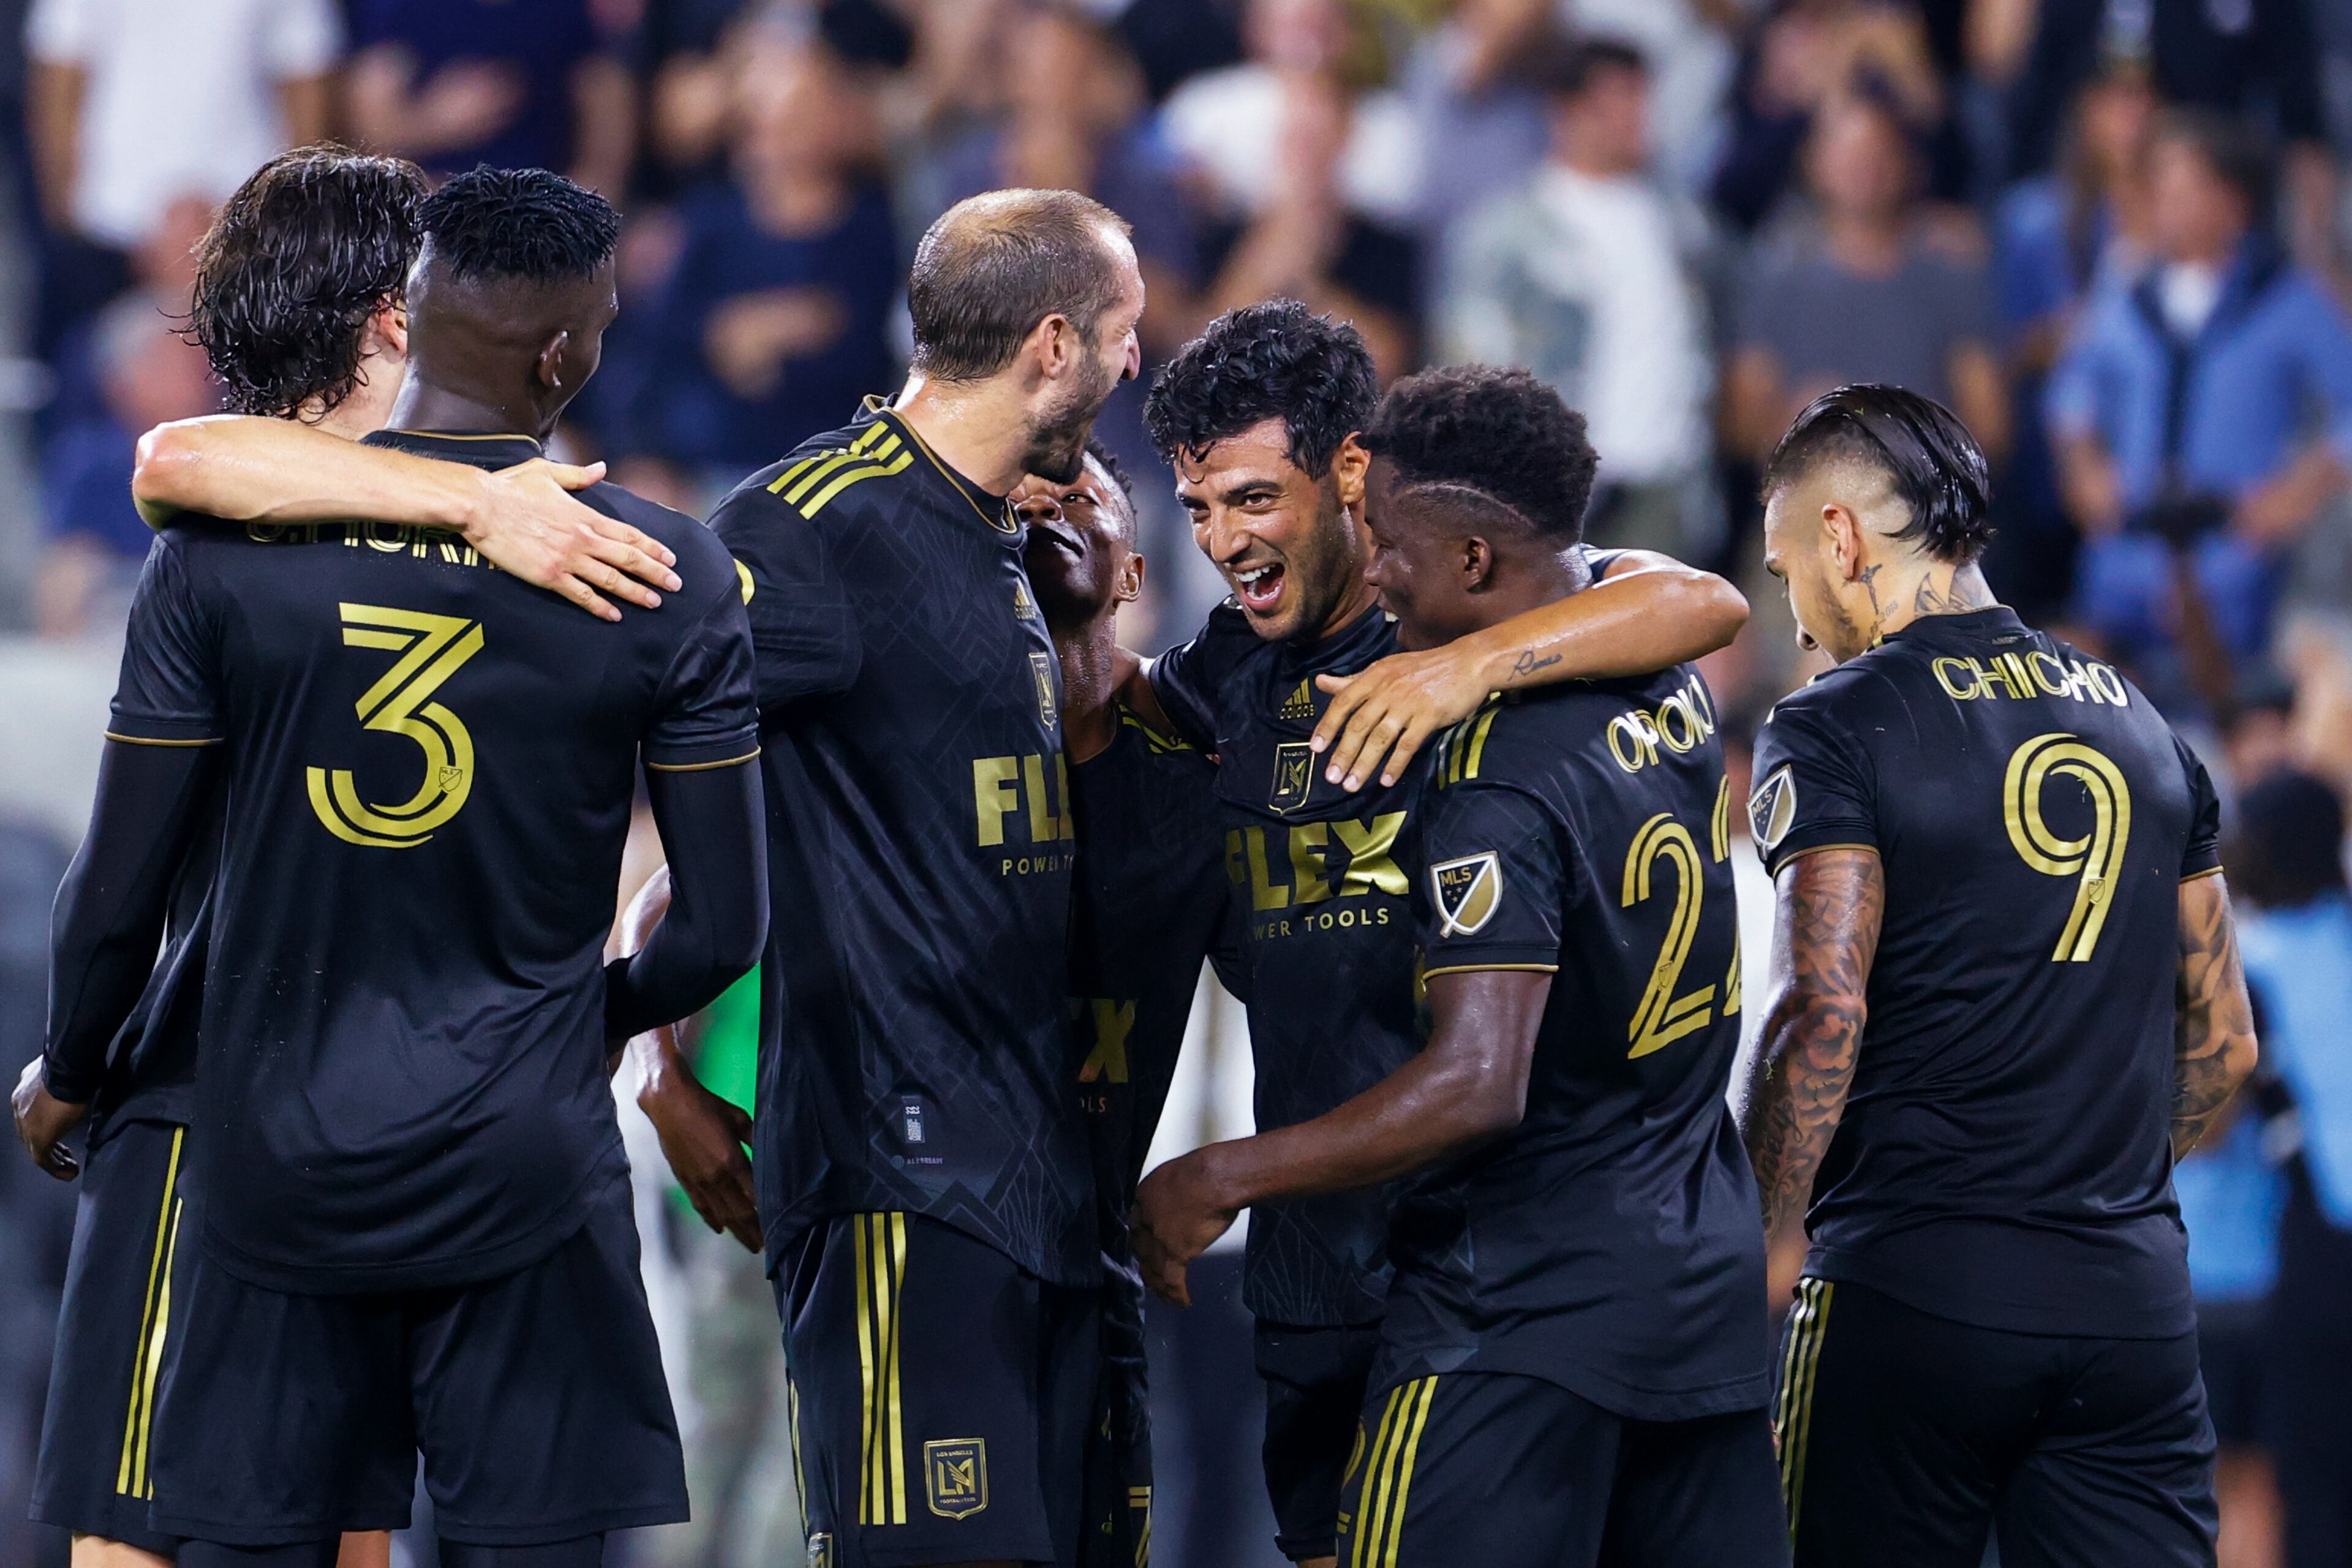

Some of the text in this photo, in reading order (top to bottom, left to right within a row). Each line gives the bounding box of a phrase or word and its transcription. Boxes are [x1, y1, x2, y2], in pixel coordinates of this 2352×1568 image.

[1931, 650, 2128, 707] CHICHO
[307, 602, 484, 848] 3
[1752, 789, 1773, 818] MLS
[2003, 733, 2131, 962] 9
[1440, 866, 1472, 888] MLS
[1305, 908, 1389, 932] TOOLS
